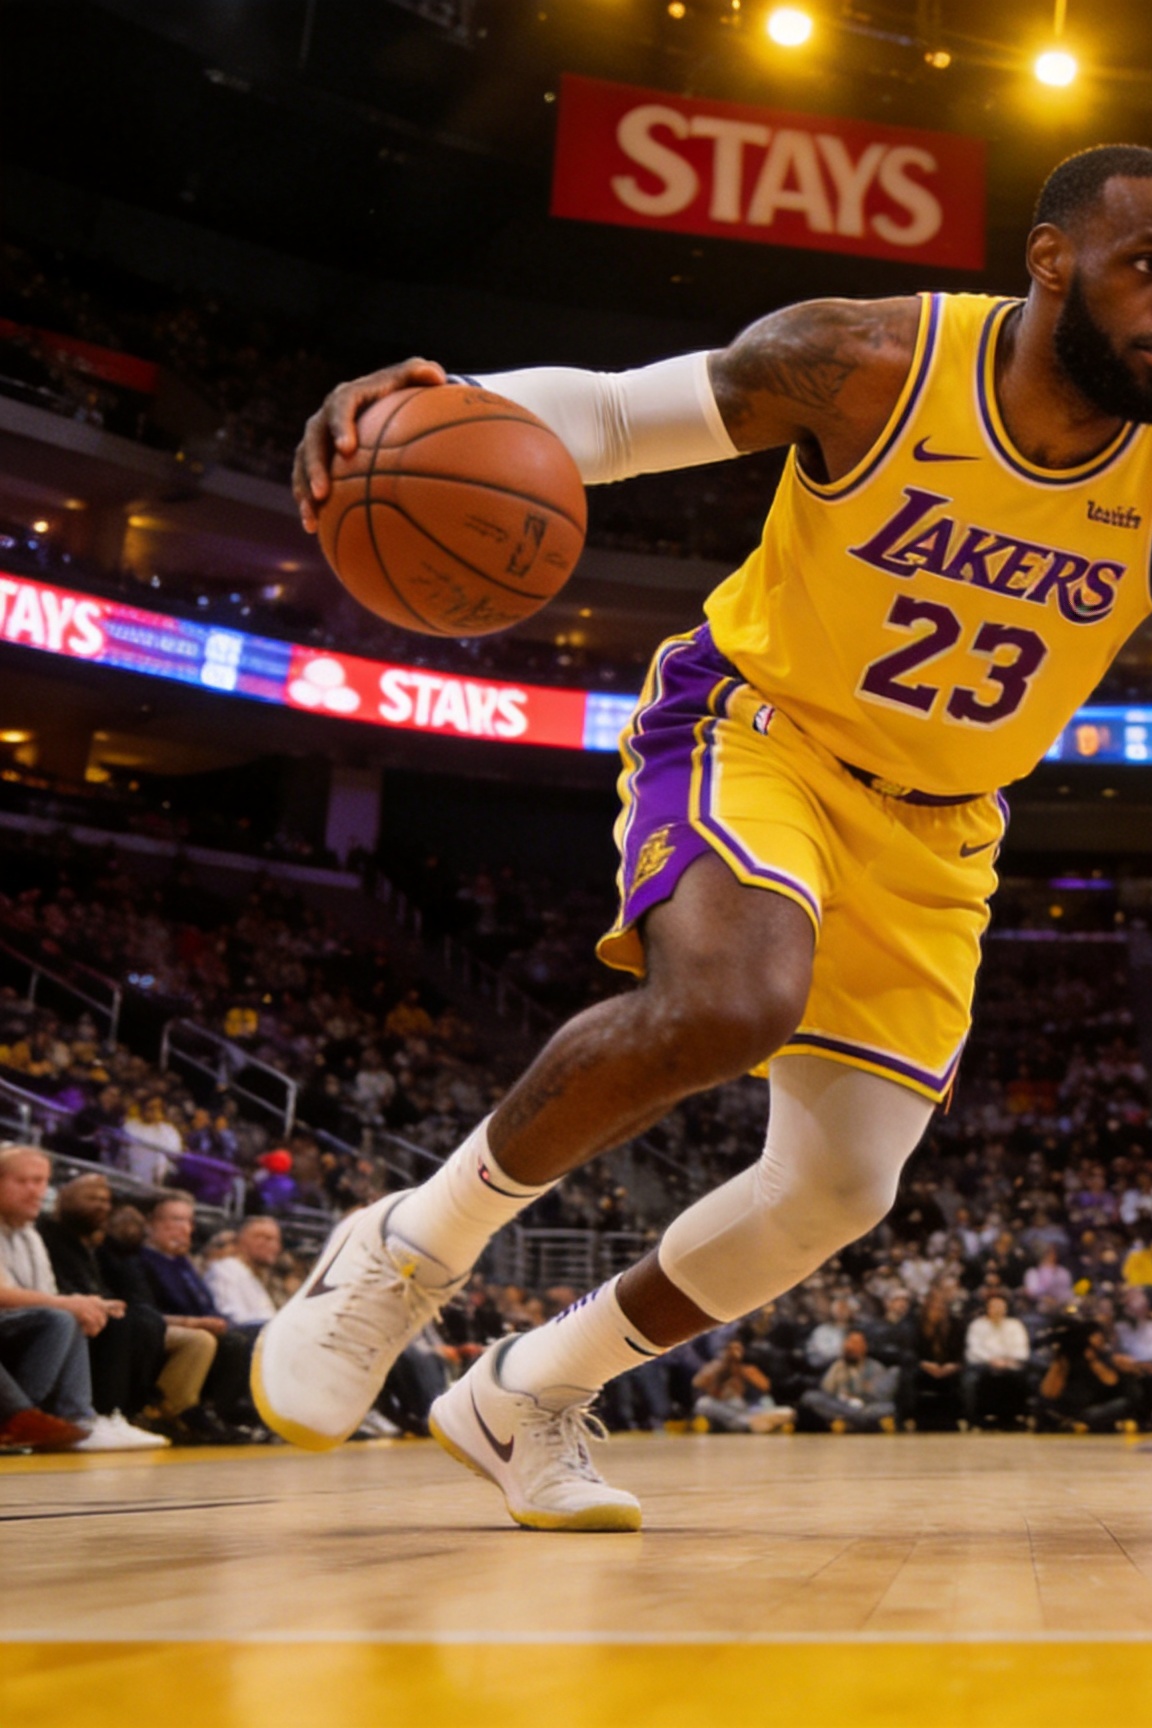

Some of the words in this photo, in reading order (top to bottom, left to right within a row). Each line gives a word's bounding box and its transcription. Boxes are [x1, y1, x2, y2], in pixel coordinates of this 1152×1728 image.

[611, 104, 943, 246] STAYS
[848, 487, 1126, 625] LAKERS
[855, 592, 1049, 727] 23
